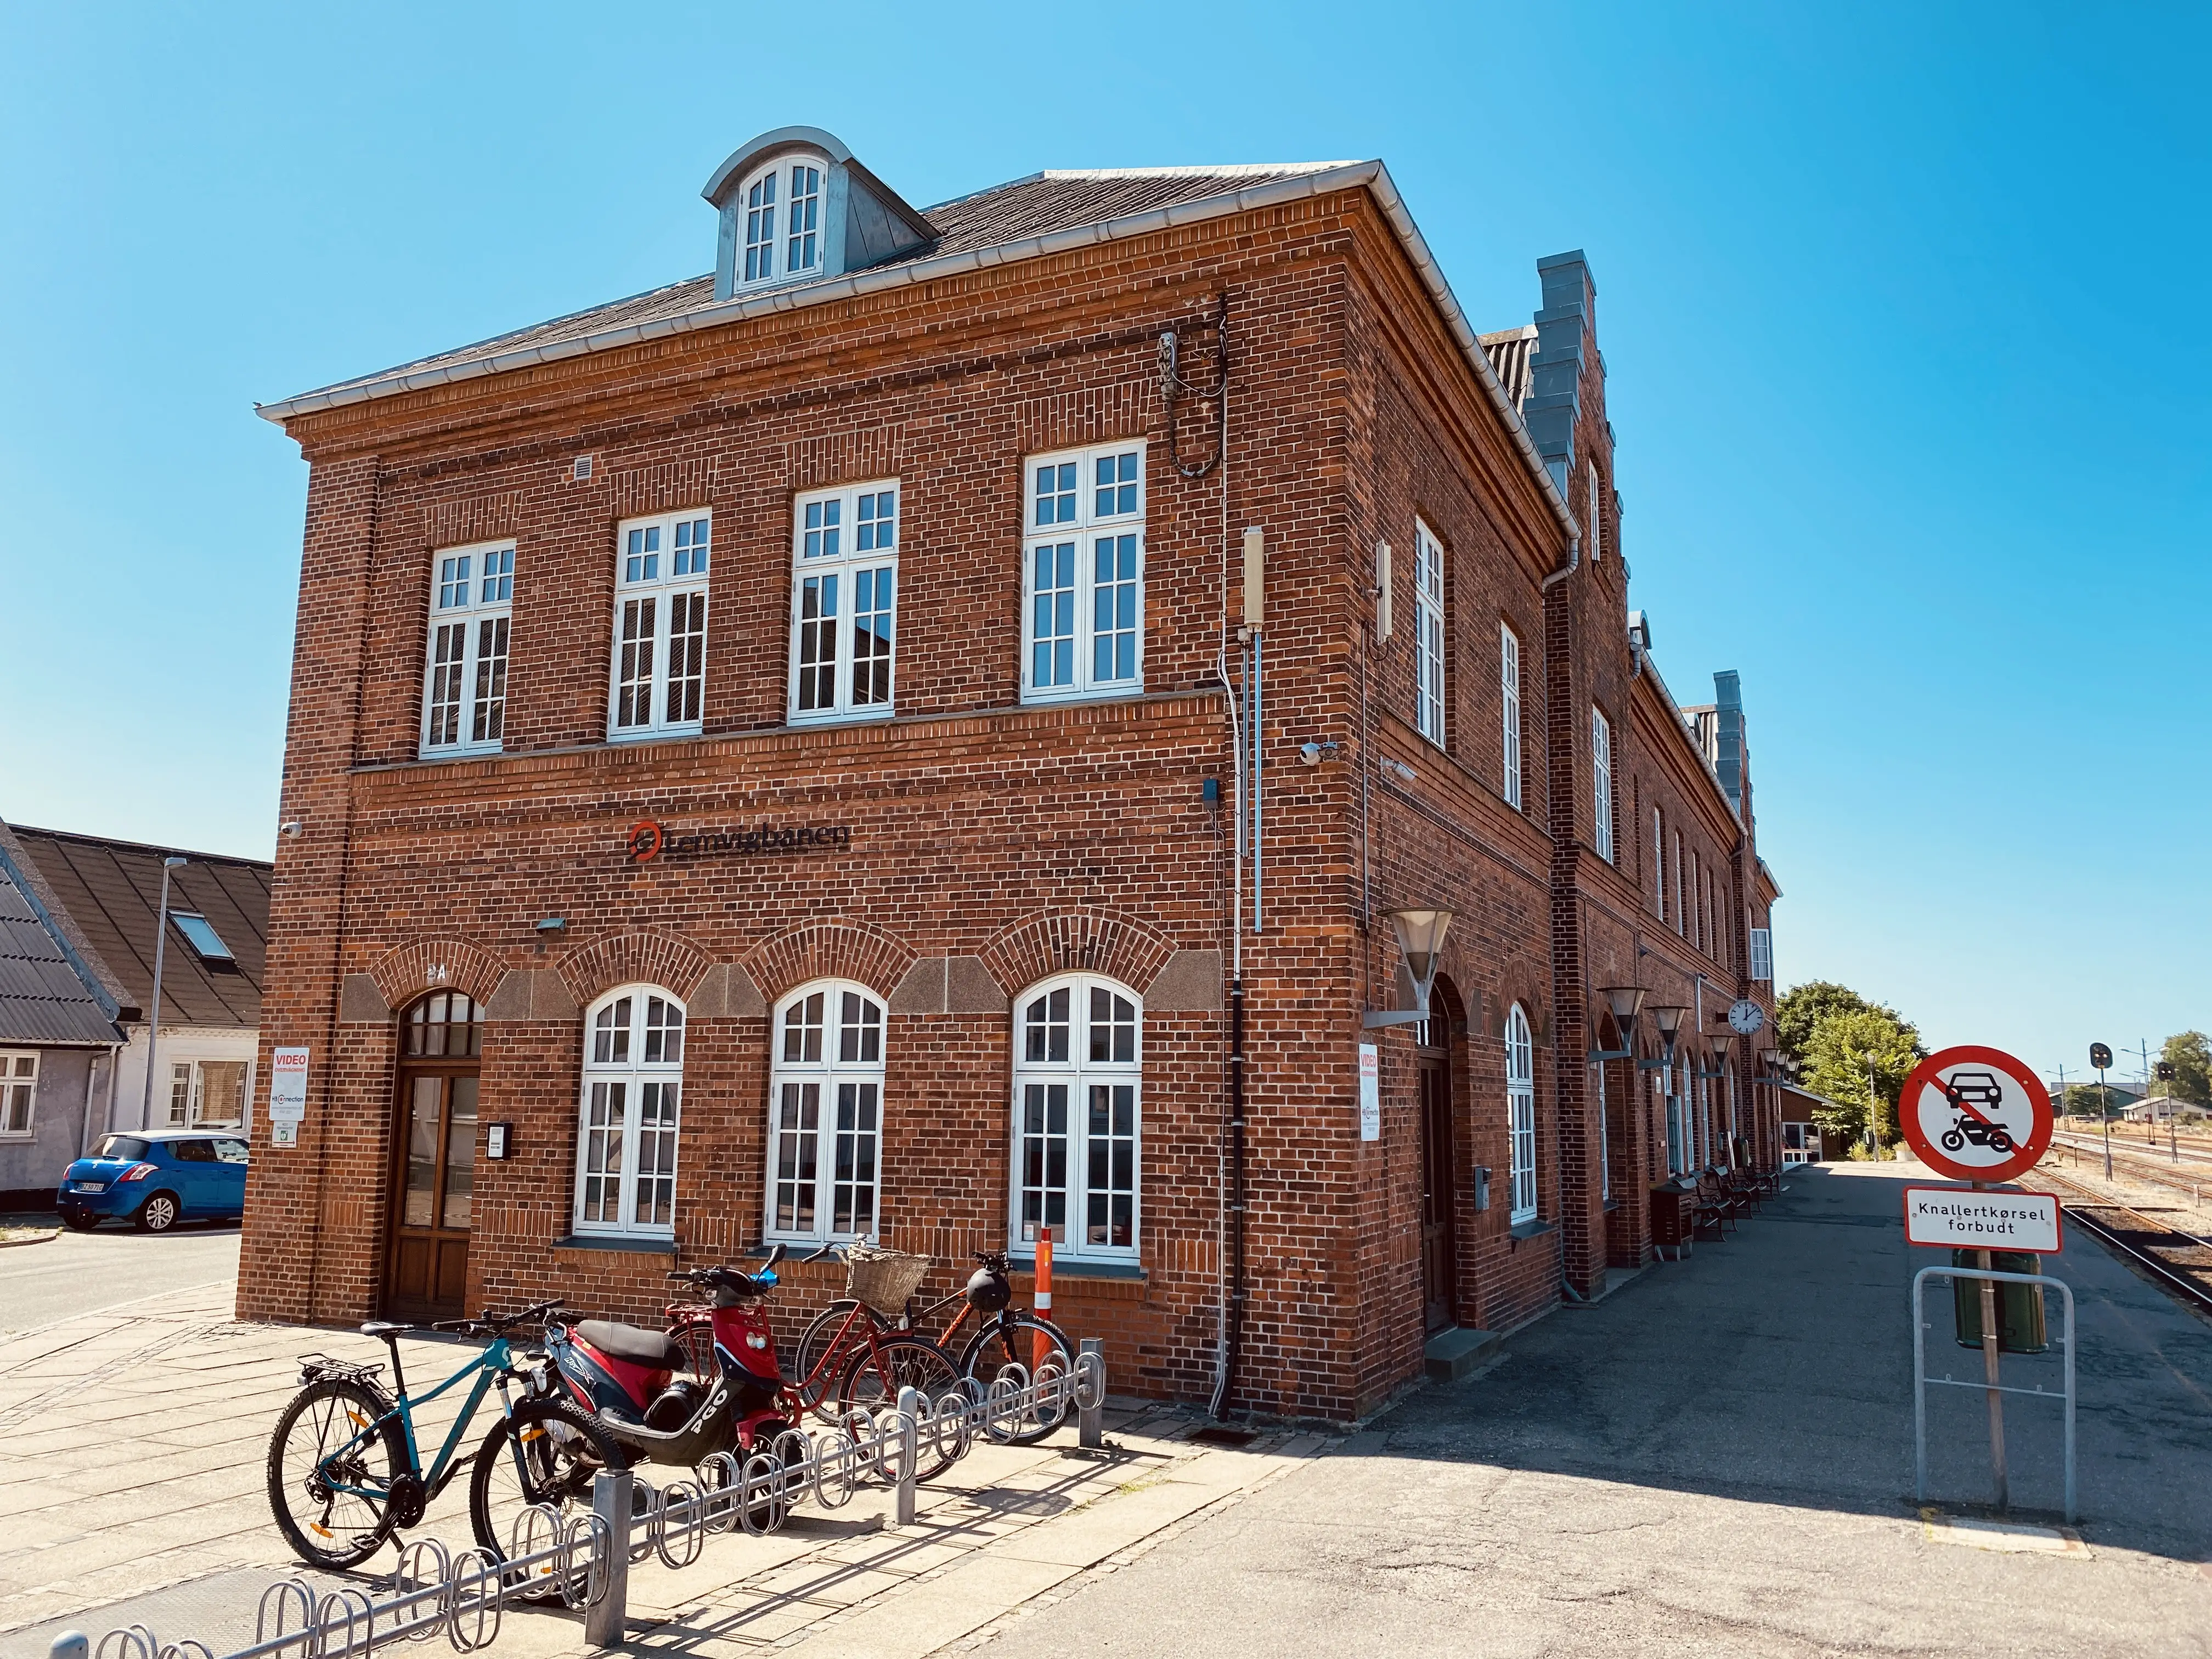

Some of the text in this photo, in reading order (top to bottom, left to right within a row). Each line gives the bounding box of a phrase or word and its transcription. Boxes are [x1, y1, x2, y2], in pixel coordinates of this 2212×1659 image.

[665, 822, 849, 854] Lemvigbanen
[427, 964, 446, 979] 2A
[276, 1054, 306, 1065] VIDEO
[1361, 1053, 1376, 1068] VIDEO
[1918, 1203, 2045, 1221] Knallertkørsel
[1948, 1219, 2015, 1234] forbudt
[690, 1389, 728, 1435] PGO
